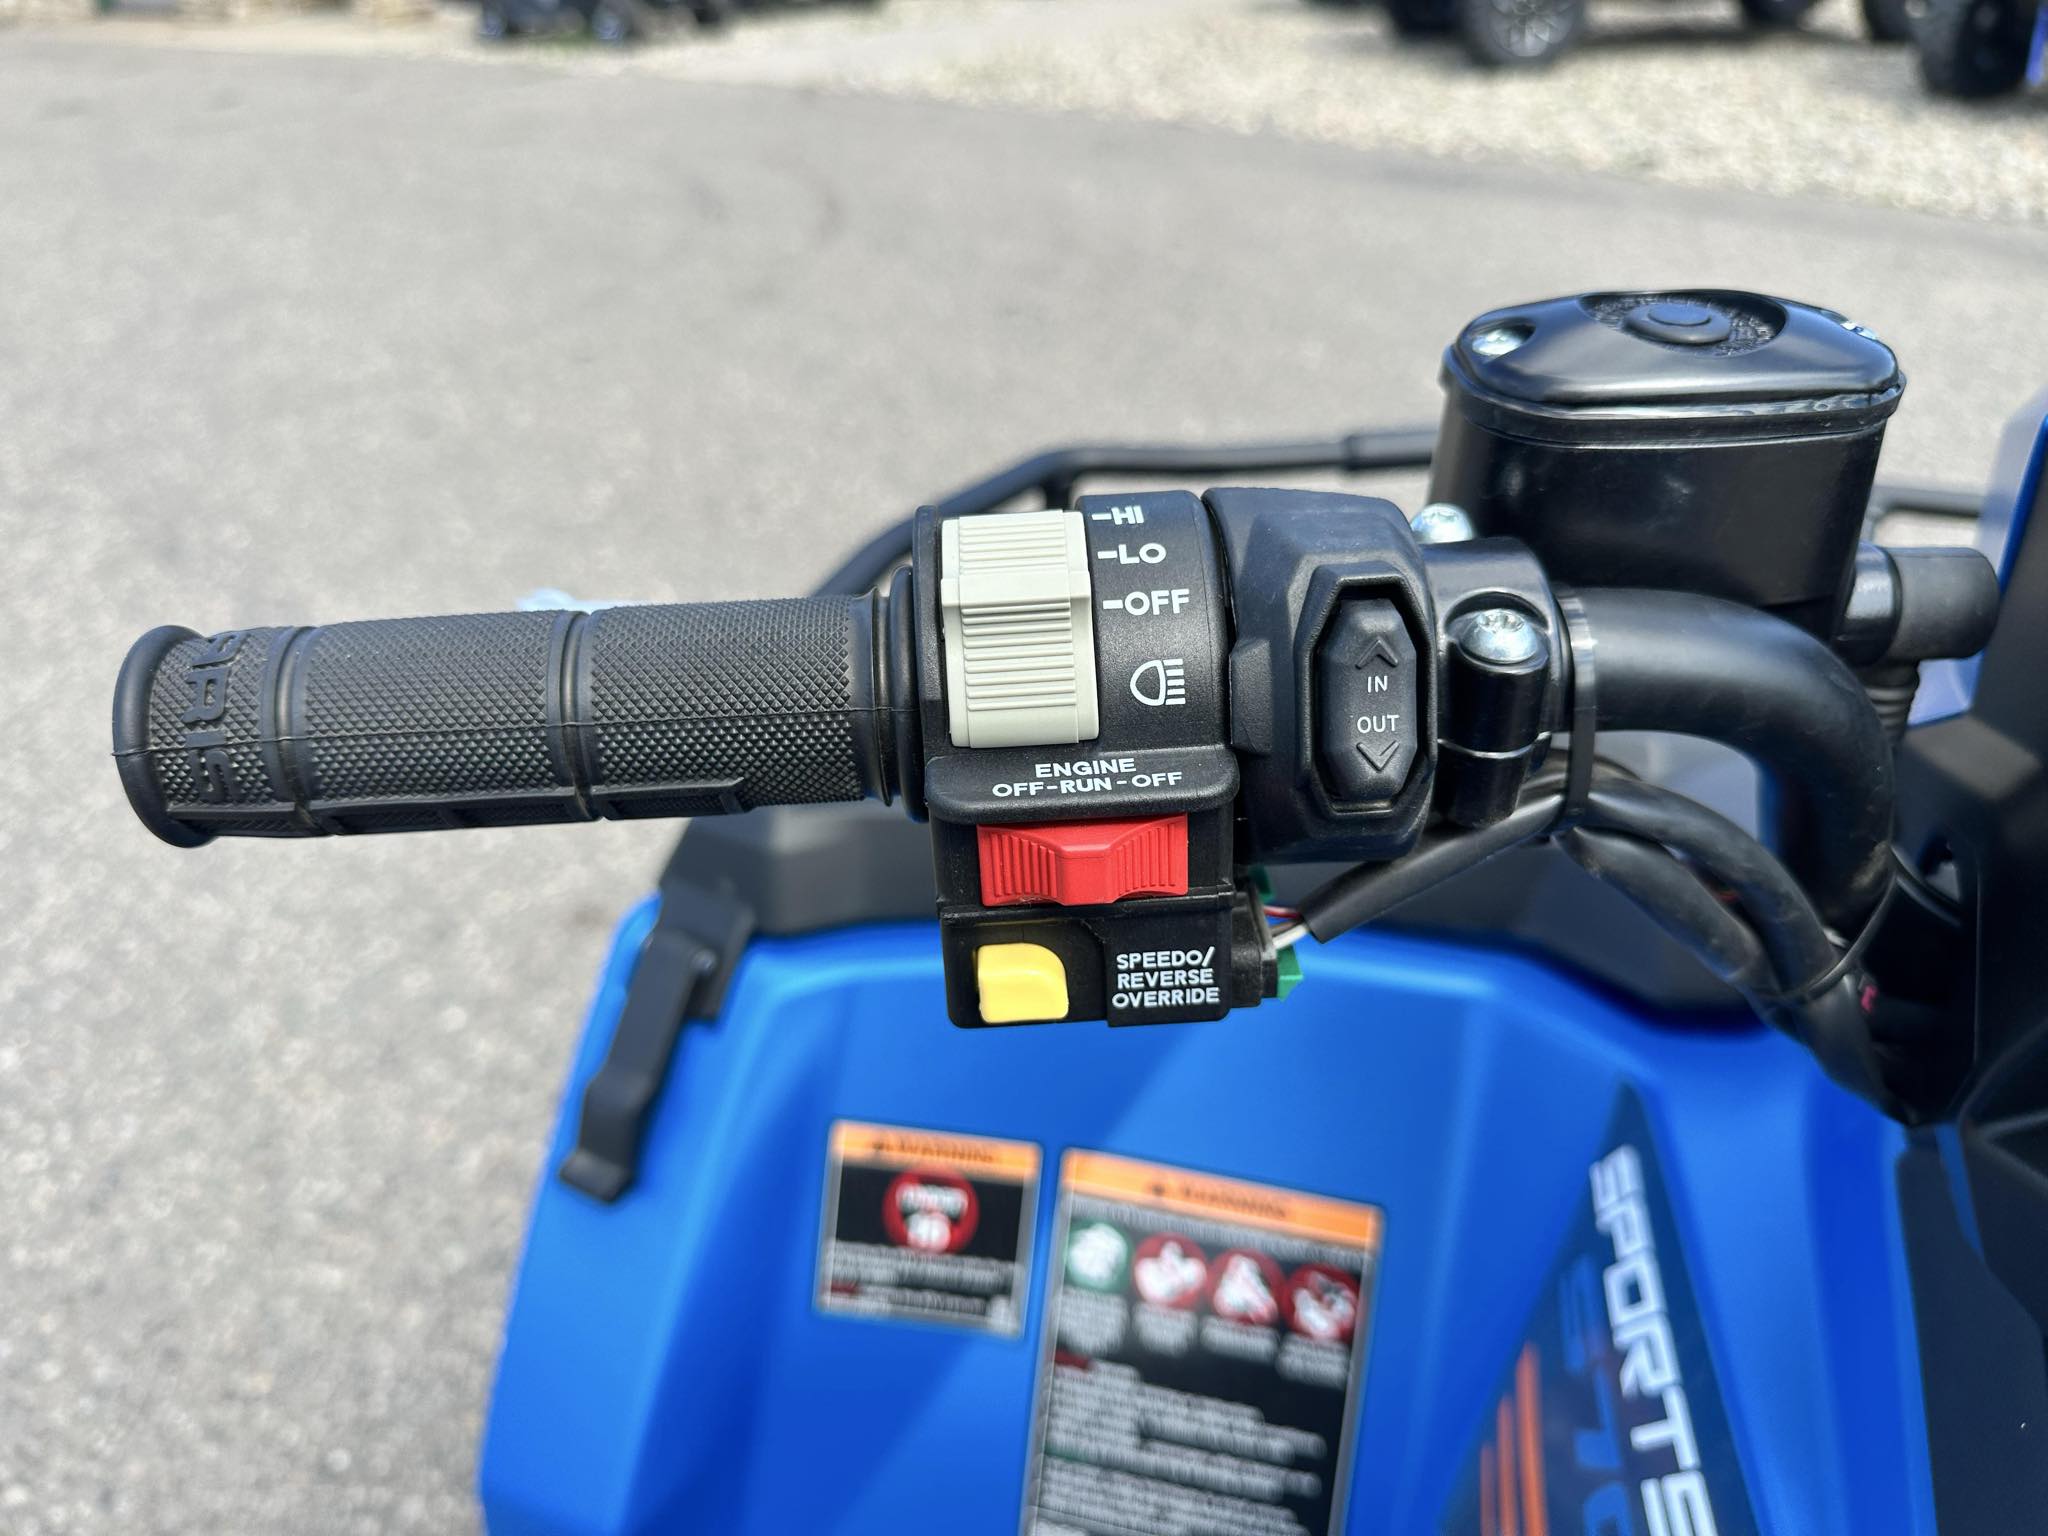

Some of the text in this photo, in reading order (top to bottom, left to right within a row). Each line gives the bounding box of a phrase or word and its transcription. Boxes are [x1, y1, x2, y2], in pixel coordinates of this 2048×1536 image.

[1367, 675, 1388, 693] IN
[1357, 714, 1400, 734] OUT
[1035, 757, 1137, 779] ENGINE
[1116, 946, 1215, 970] SPEEDO/
[1117, 967, 1214, 989] REVERSE
[1112, 987, 1220, 1009] OVERRIDE
